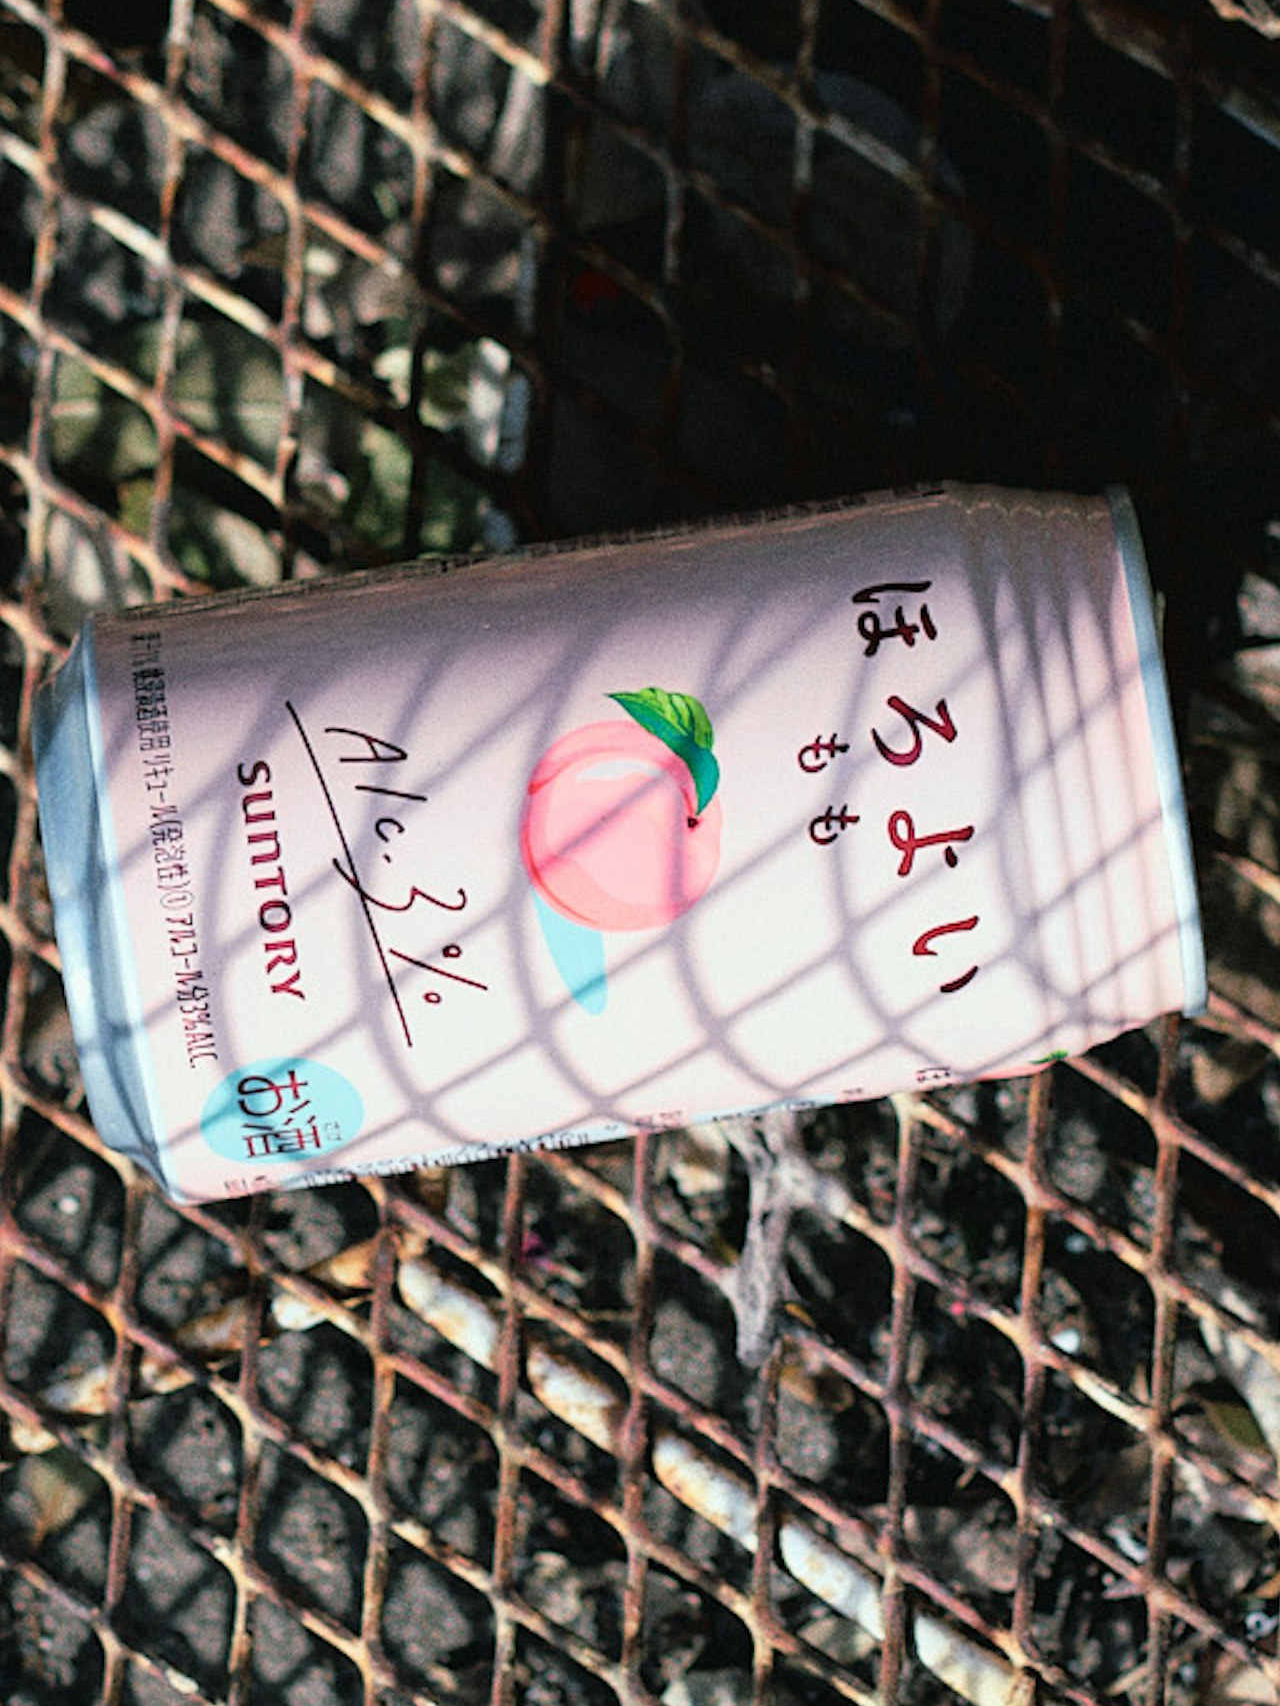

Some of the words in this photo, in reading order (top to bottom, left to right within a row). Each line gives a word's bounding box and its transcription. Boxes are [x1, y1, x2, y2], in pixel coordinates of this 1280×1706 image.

[798, 733, 859, 845] もも
[852, 580, 979, 993] ほろよい
[237, 760, 305, 1001] SUNTORY
[237, 1069, 321, 1158] お酒
